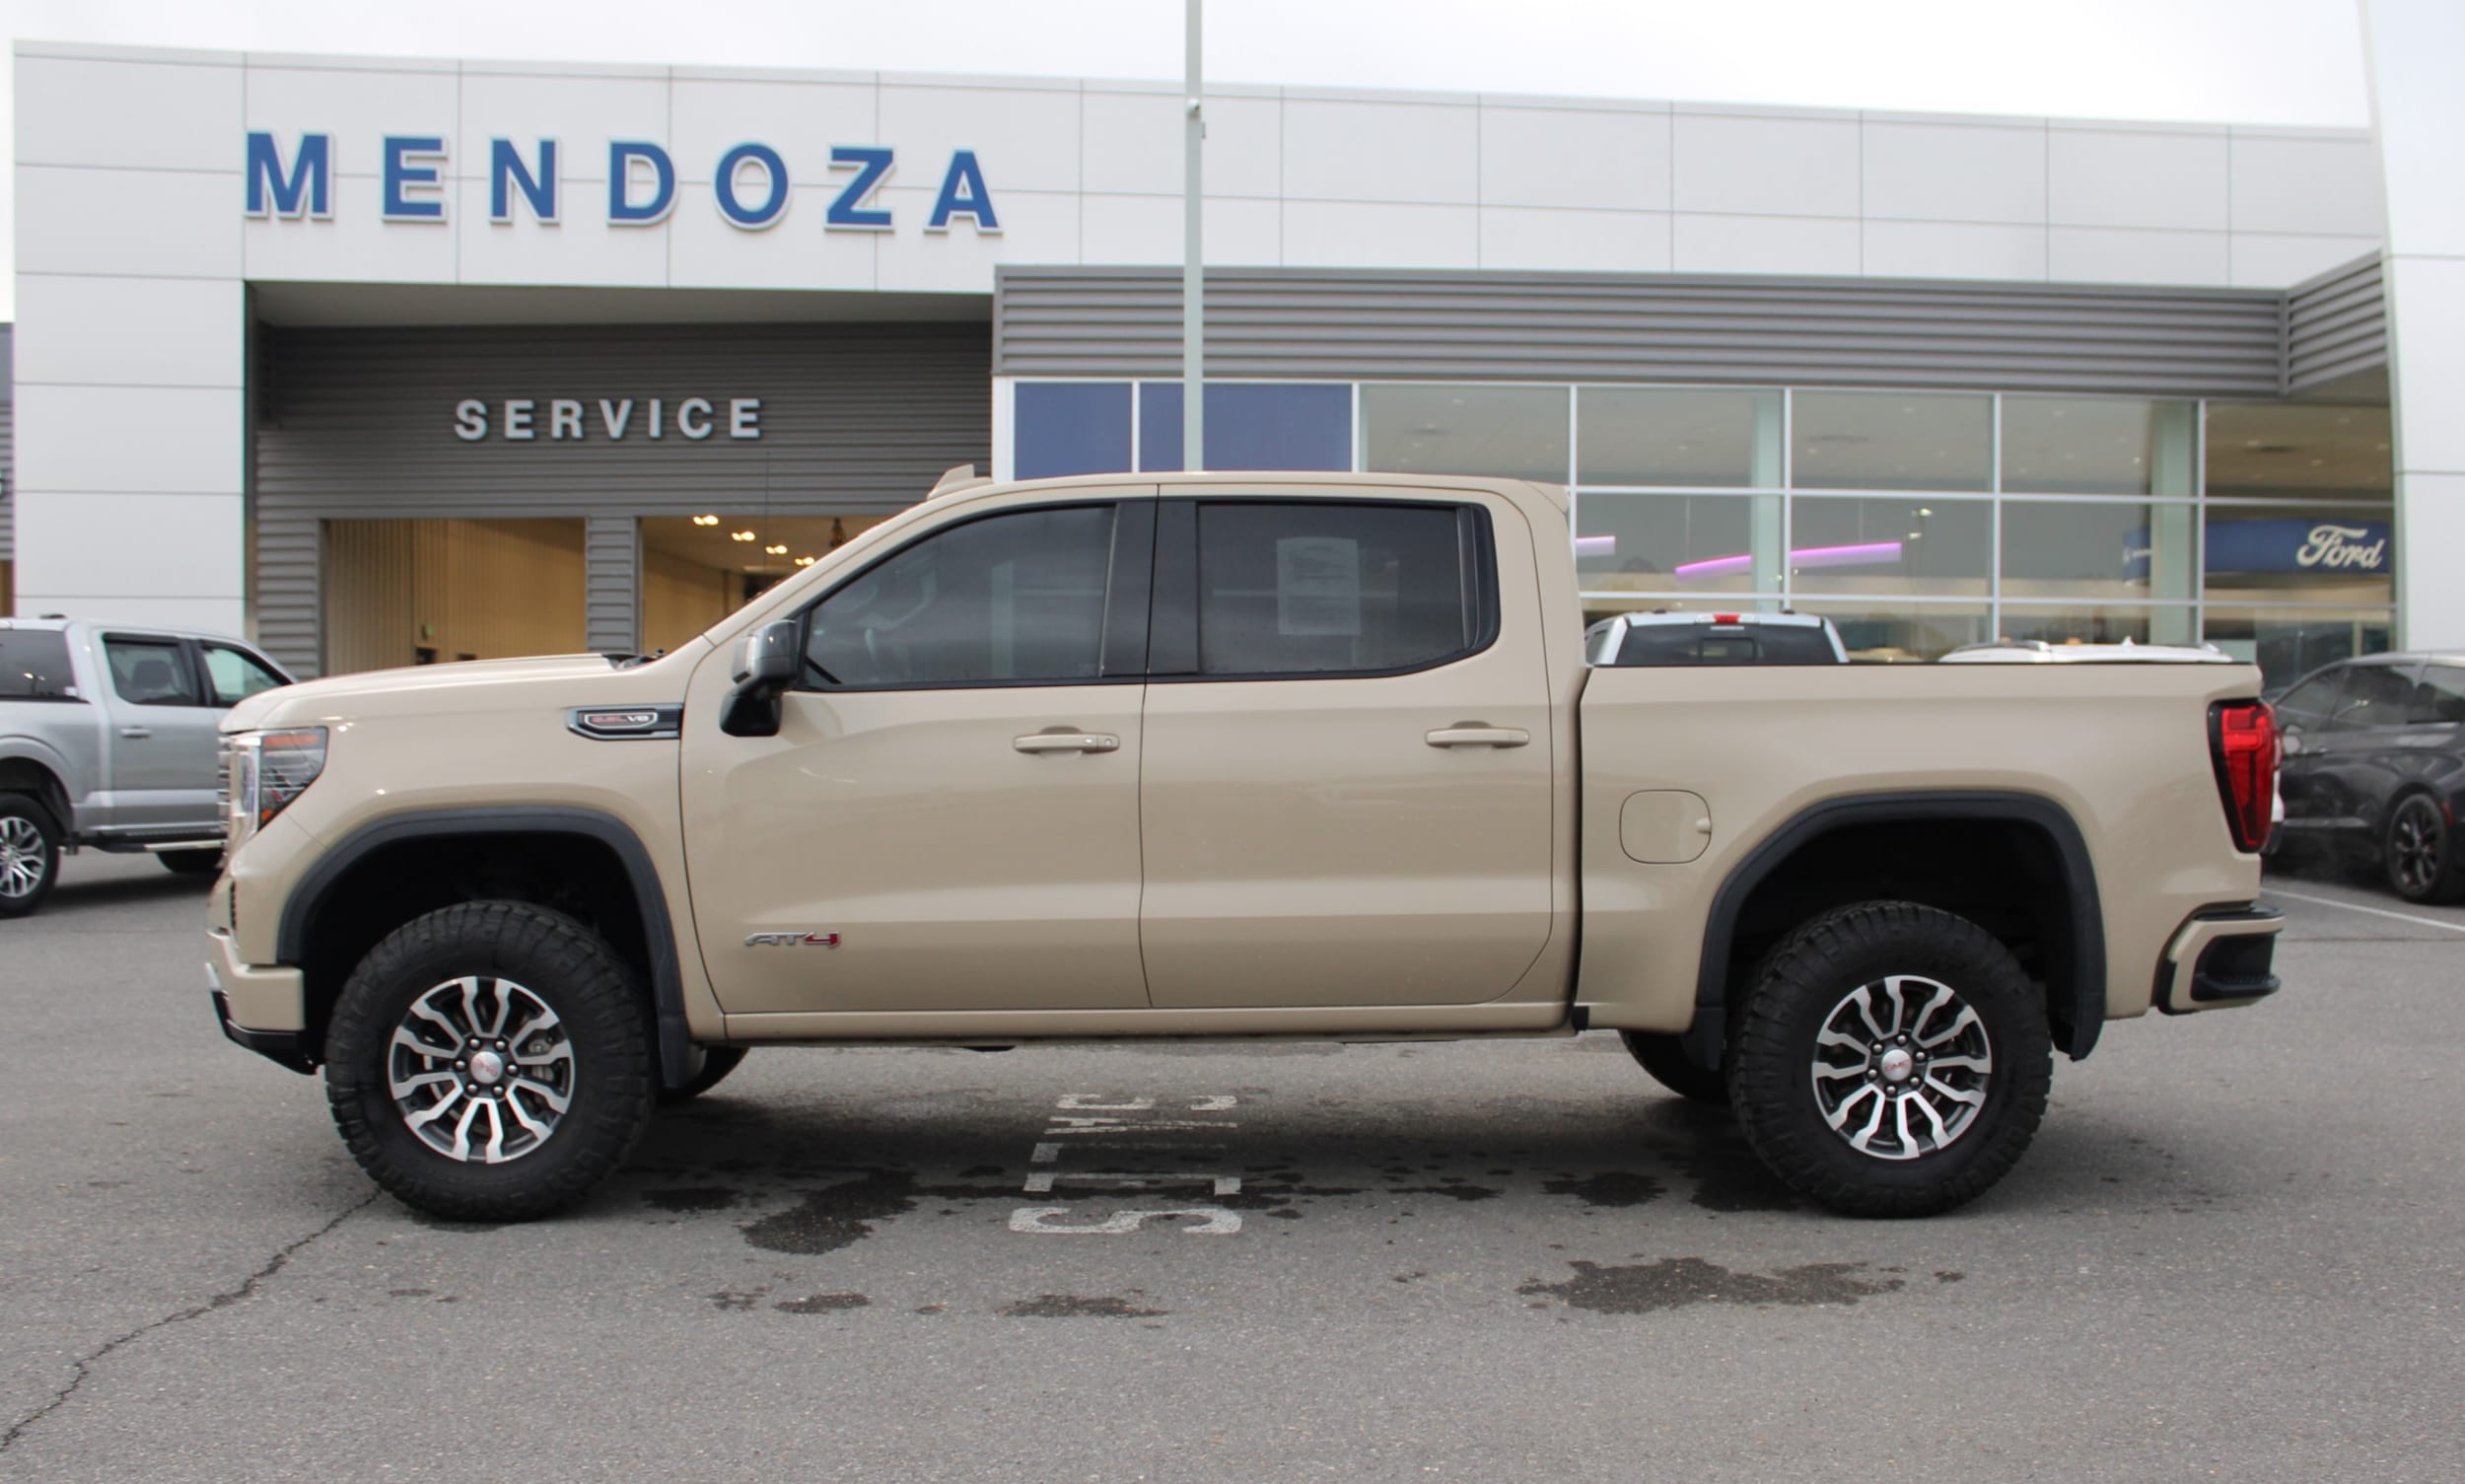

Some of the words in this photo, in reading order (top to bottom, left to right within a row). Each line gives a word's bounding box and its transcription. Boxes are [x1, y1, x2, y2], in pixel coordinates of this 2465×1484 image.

[245, 130, 1002, 234] MENDOZA
[455, 397, 761, 440] SERVICE
[2296, 524, 2385, 569] Ford
[744, 931, 840, 948] AT4
